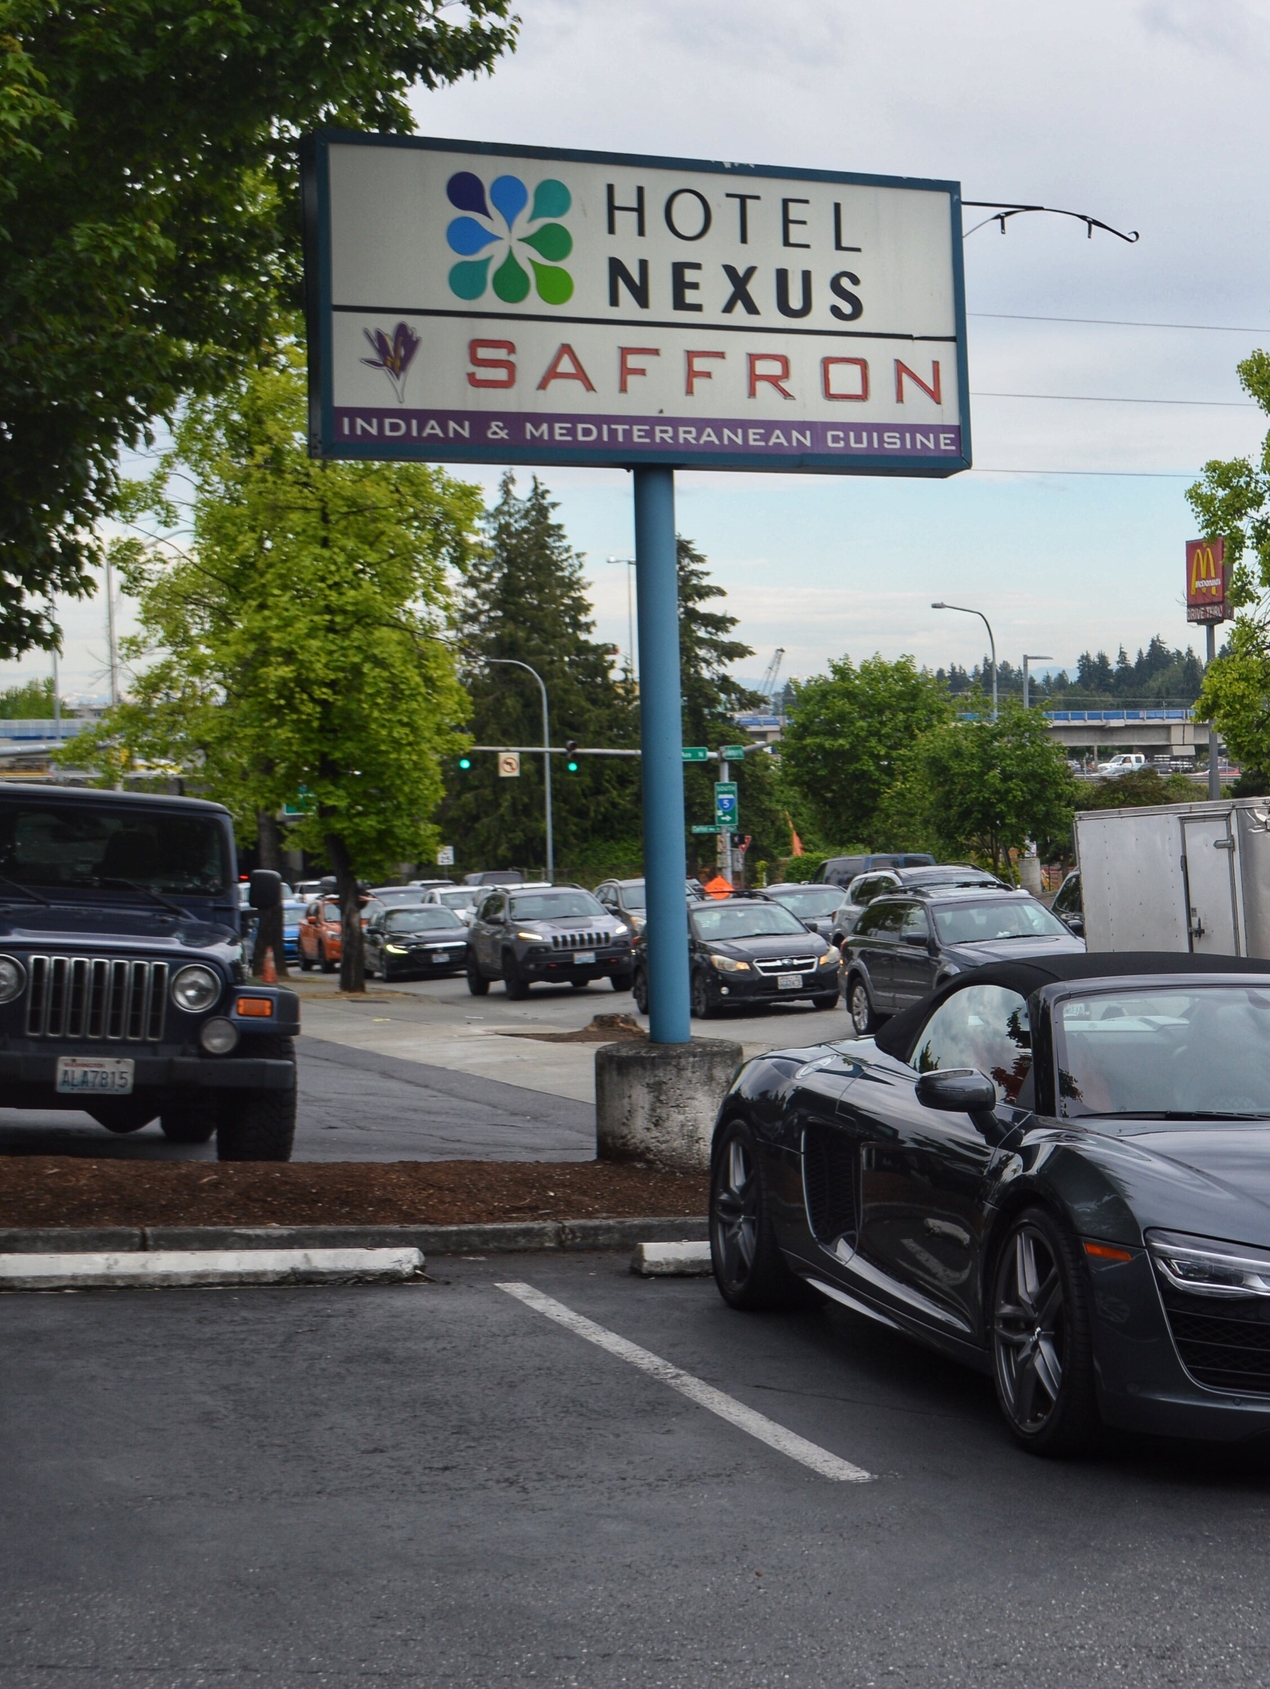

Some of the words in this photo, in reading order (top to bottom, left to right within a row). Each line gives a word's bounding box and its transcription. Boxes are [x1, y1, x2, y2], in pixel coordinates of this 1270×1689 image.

[606, 182, 863, 253] HOTEL
[608, 256, 864, 322] NEXUS
[467, 338, 942, 405] SAFFRON
[342, 417, 470, 439] INDIAN
[486, 421, 510, 440] &
[525, 422, 812, 448] MEDITERRANEAN
[827, 430, 956, 450] CUISINE
[722, 799, 730, 809] 5
[61, 1069, 129, 1088] ALA7815
